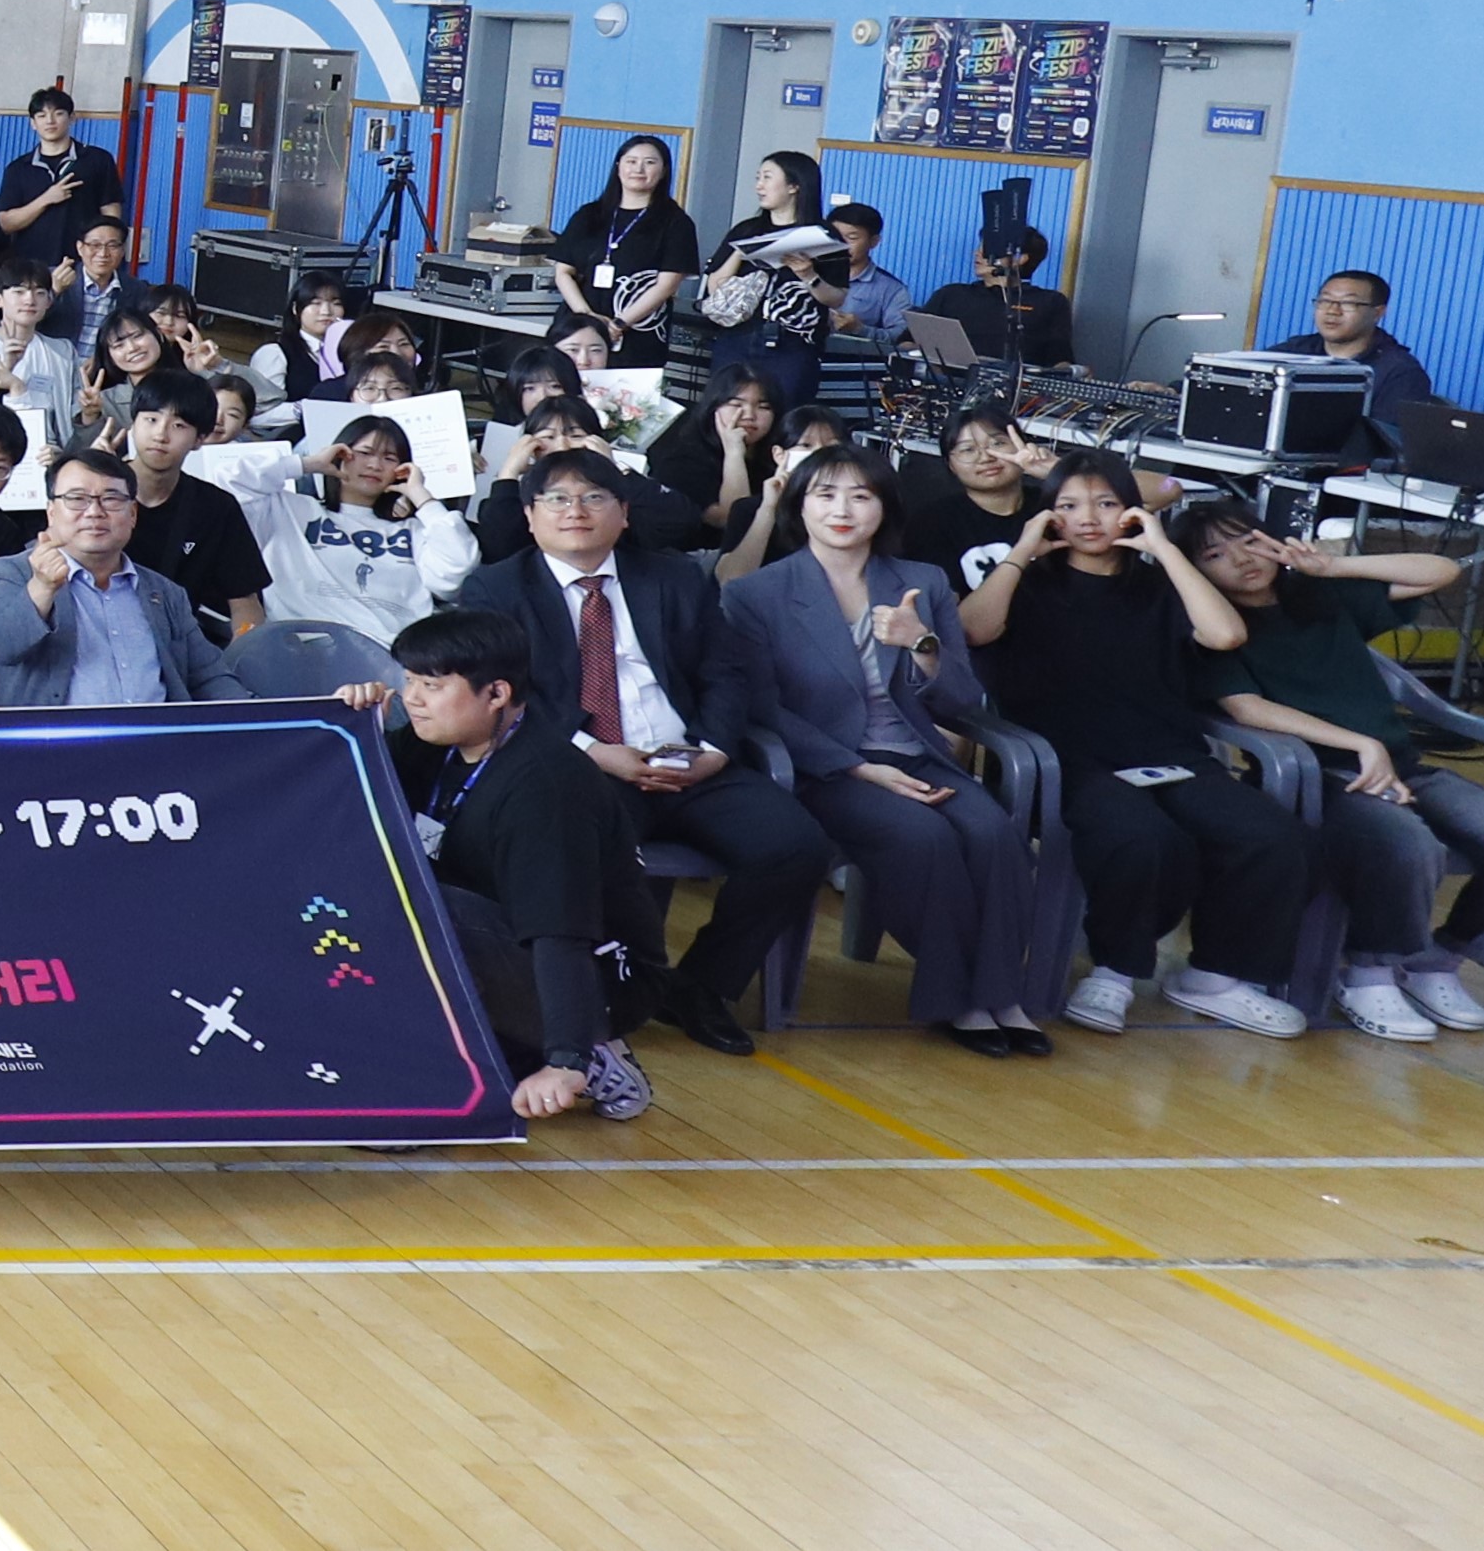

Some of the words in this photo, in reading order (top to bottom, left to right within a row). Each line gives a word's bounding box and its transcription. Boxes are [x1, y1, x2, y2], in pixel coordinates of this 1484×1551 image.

[1040, 56, 1090, 80] FESTA
[305, 517, 413, 558] 1583
[16, 792, 200, 848] 17:00
[1346, 1006, 1389, 1034] crocs
